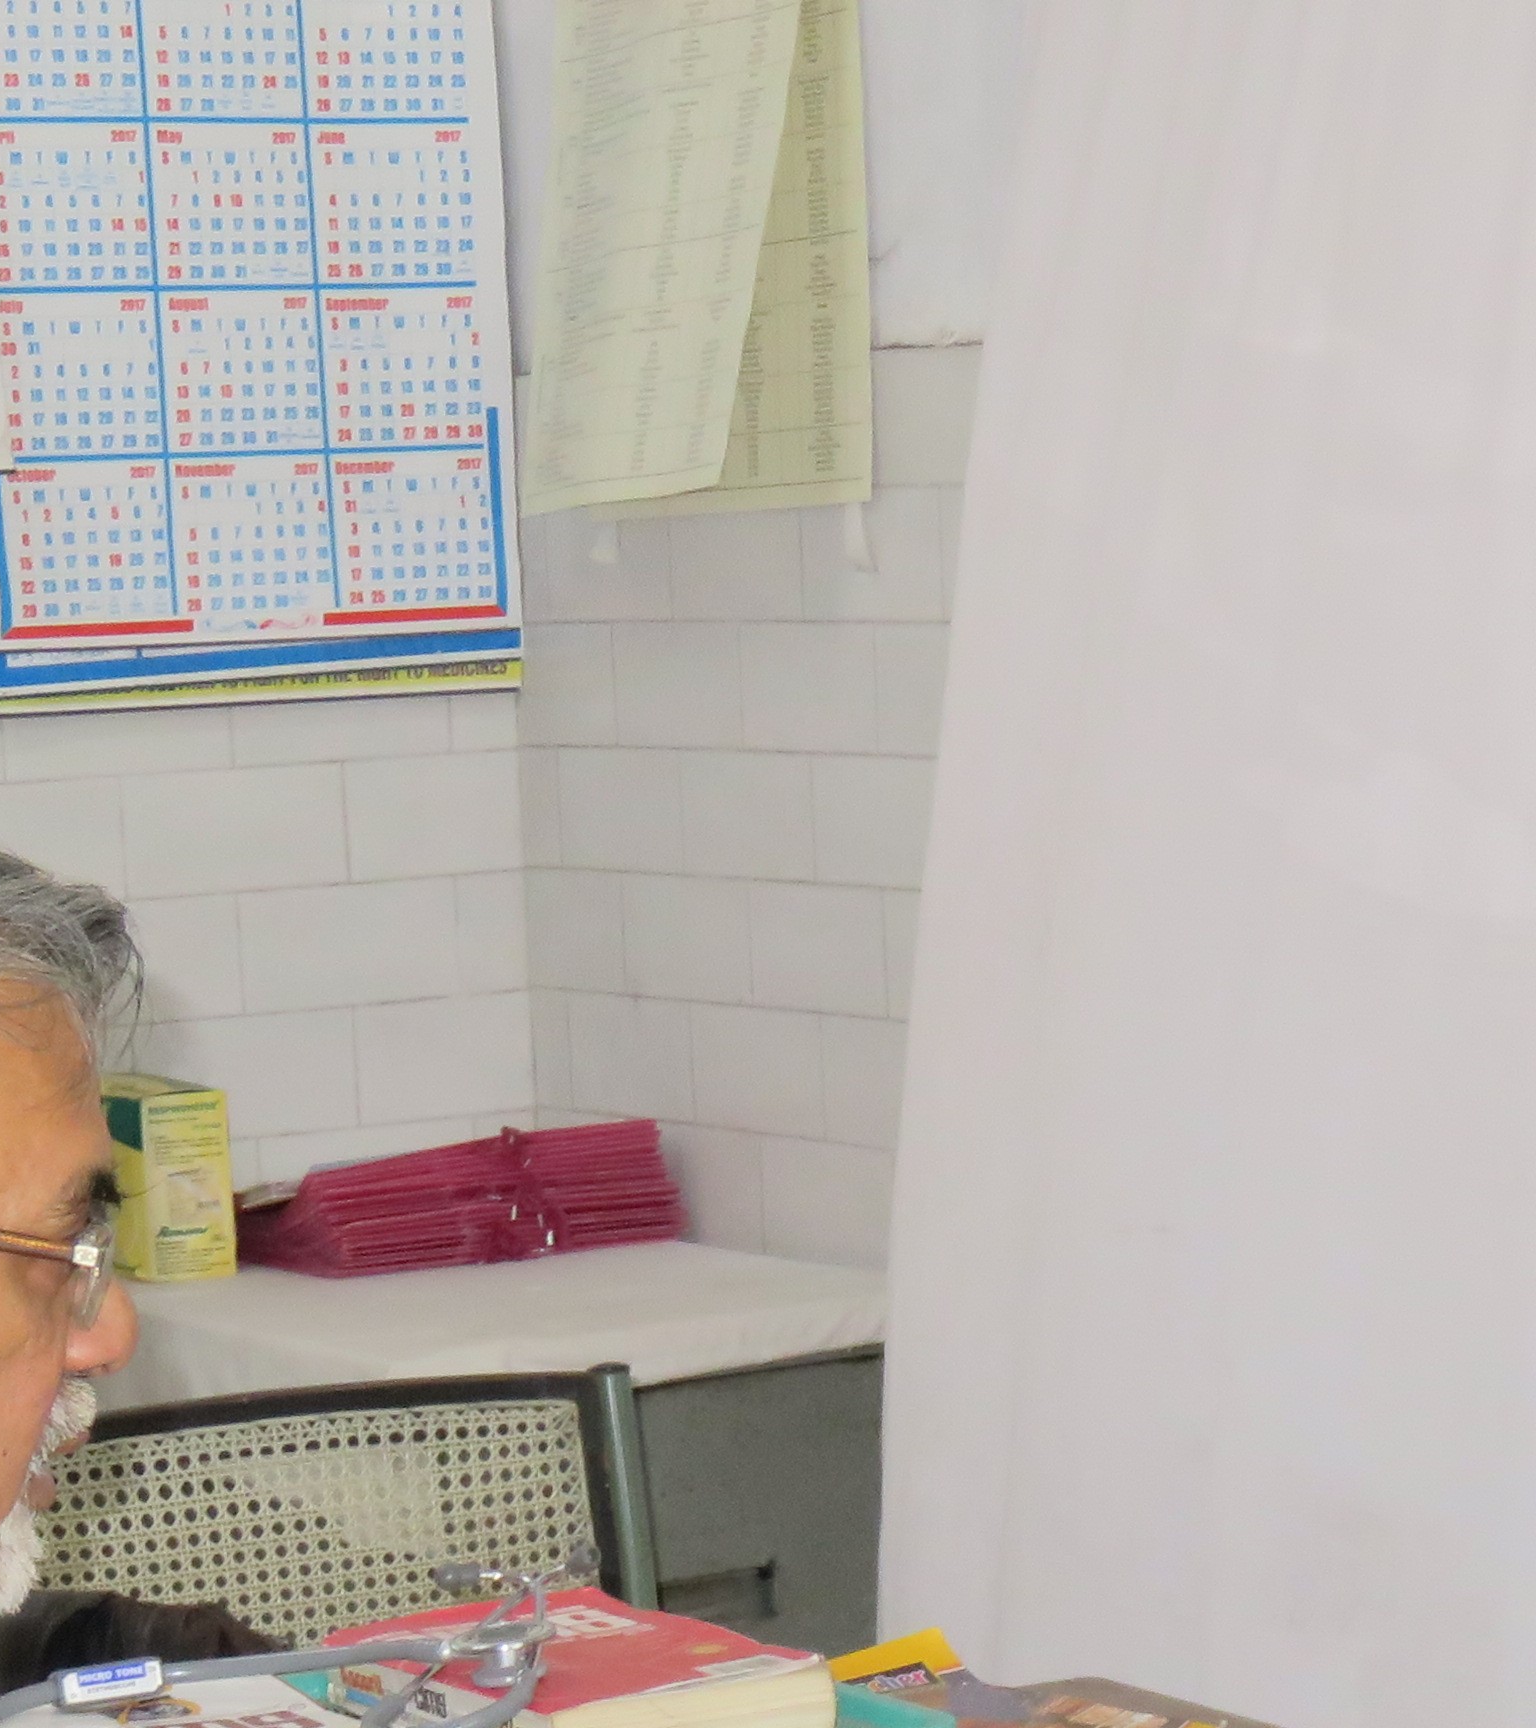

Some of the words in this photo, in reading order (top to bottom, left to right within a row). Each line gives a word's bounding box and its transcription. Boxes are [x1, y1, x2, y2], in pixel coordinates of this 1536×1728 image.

[111, 130, 136, 142] 2017
[157, 129, 182, 144] May
[272, 132, 295, 144] 2017
[318, 131, 345, 144] June
[435, 131, 461, 142] 2017
[121, 299, 145, 311] 2017
[169, 297, 208, 312] August
[283, 297, 306, 309] 2017
[326, 297, 389, 312] September
[447, 296, 472, 308] 2017
[130, 466, 155, 478] 2017
[175, 463, 235, 477] November
[294, 463, 318, 475] 2017
[335, 461, 394, 474] December
[457, 458, 482, 470] 2017
[114, 1665, 143, 1679] TONE
